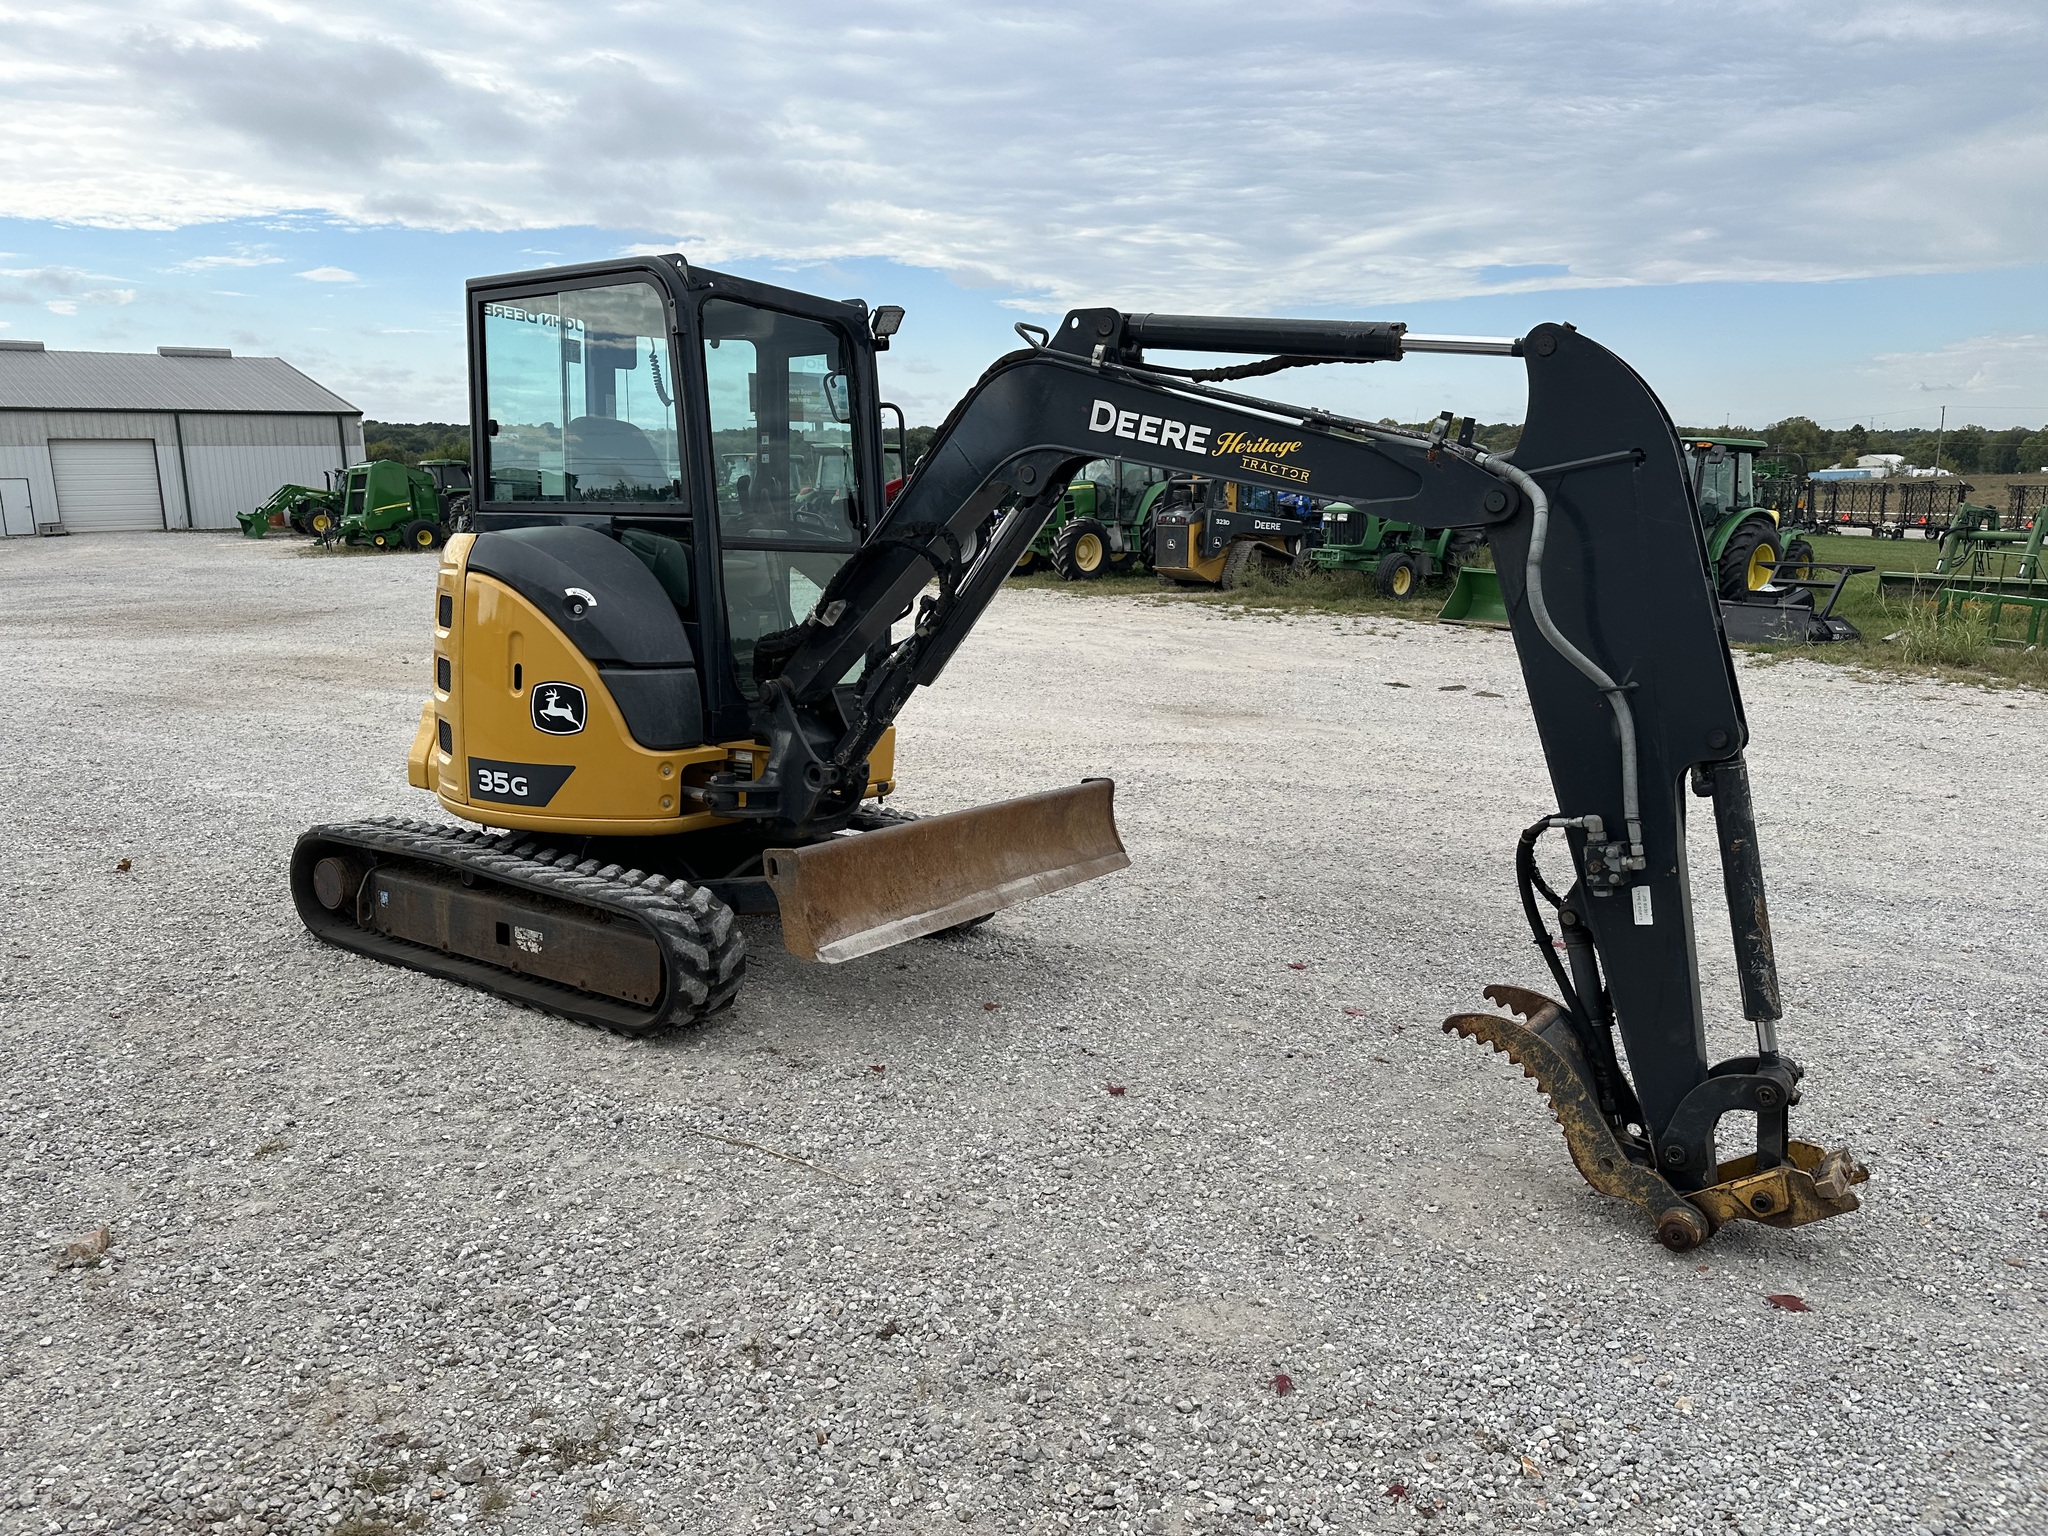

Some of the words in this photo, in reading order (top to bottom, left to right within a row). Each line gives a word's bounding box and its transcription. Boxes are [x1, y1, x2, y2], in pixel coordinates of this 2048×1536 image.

[1088, 399, 1212, 455] DEERE
[1211, 431, 1303, 458] Heritage
[1241, 457, 1310, 483] TRACTOR
[1254, 519, 1282, 531] DEERE
[478, 769, 528, 796] 35G
